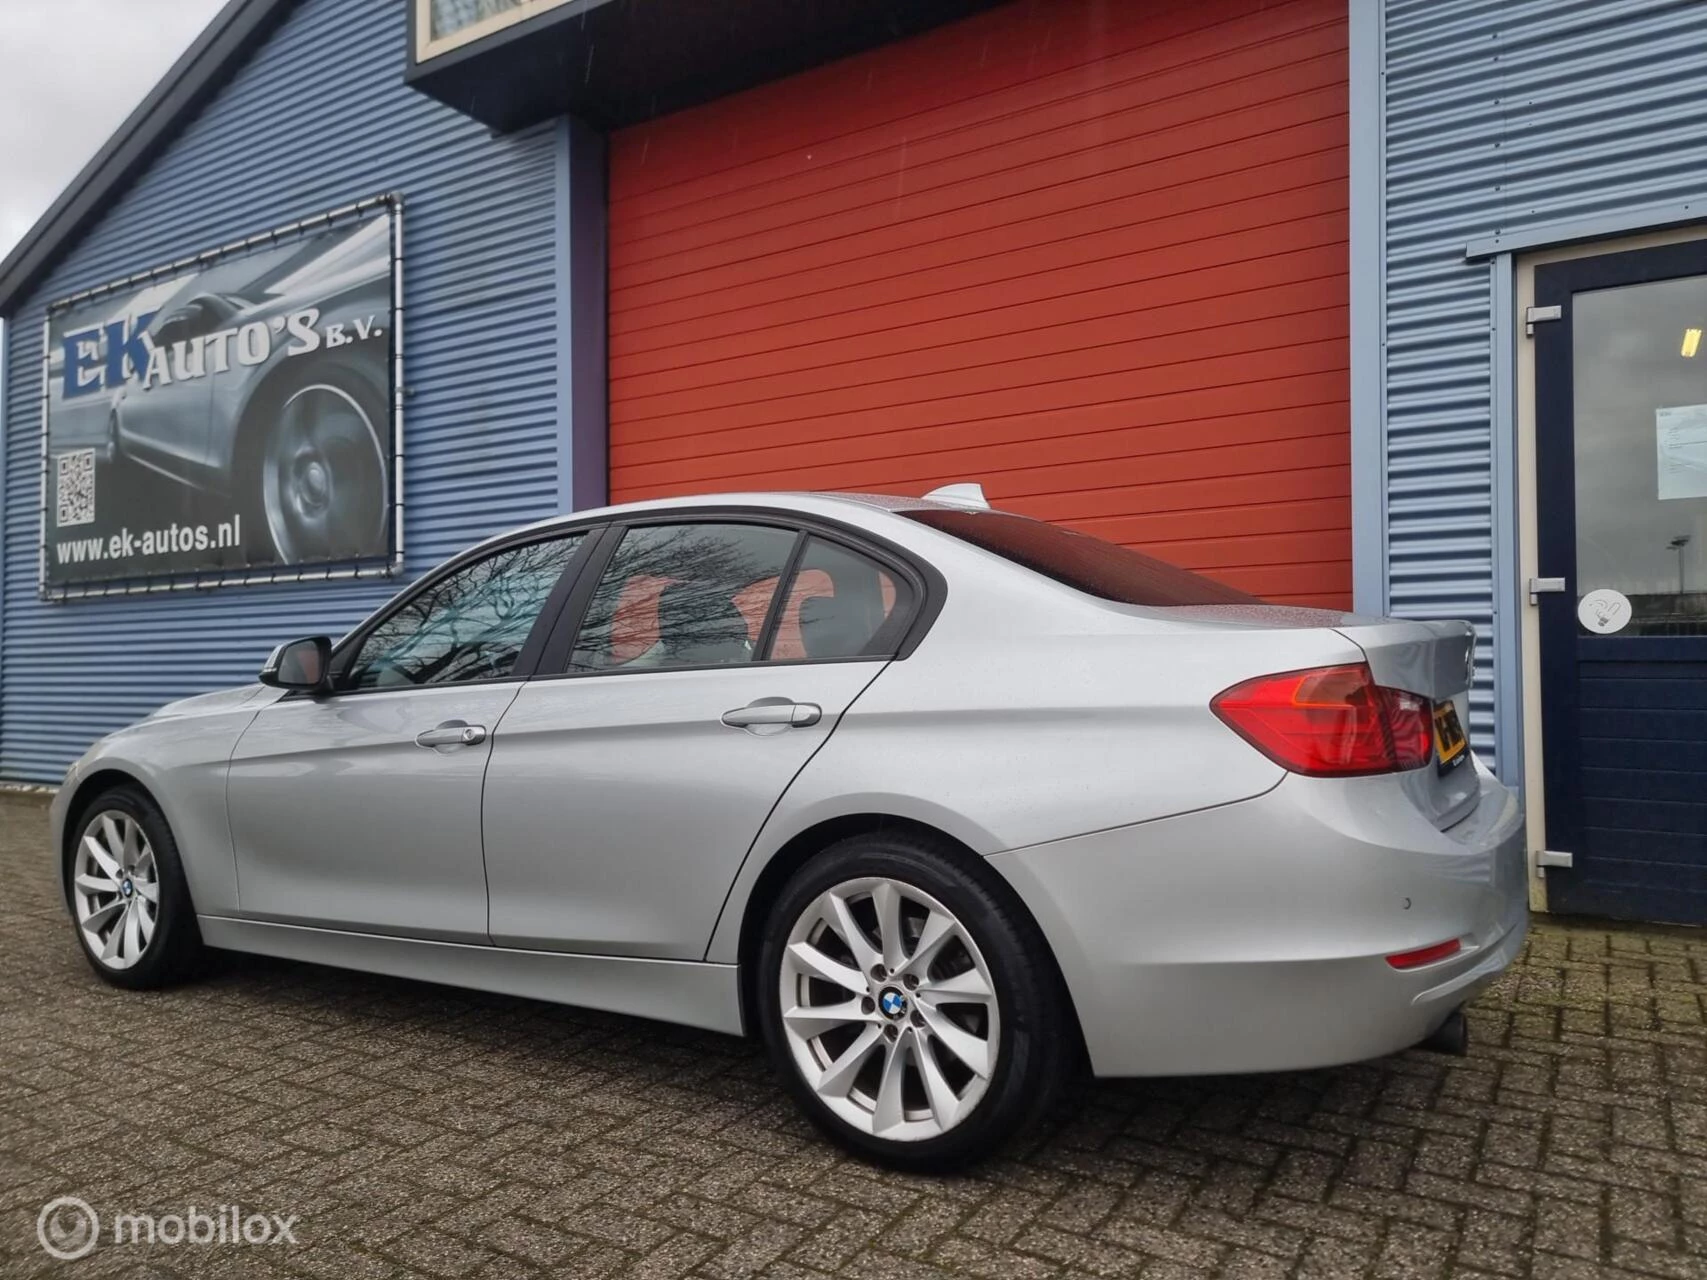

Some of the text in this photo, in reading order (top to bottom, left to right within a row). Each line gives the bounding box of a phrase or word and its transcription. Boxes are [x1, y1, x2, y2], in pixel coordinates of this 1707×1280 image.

[62, 307, 383, 399] EK AUTO'S B.V.
[56, 513, 241, 564] www.ek-autos.nl
